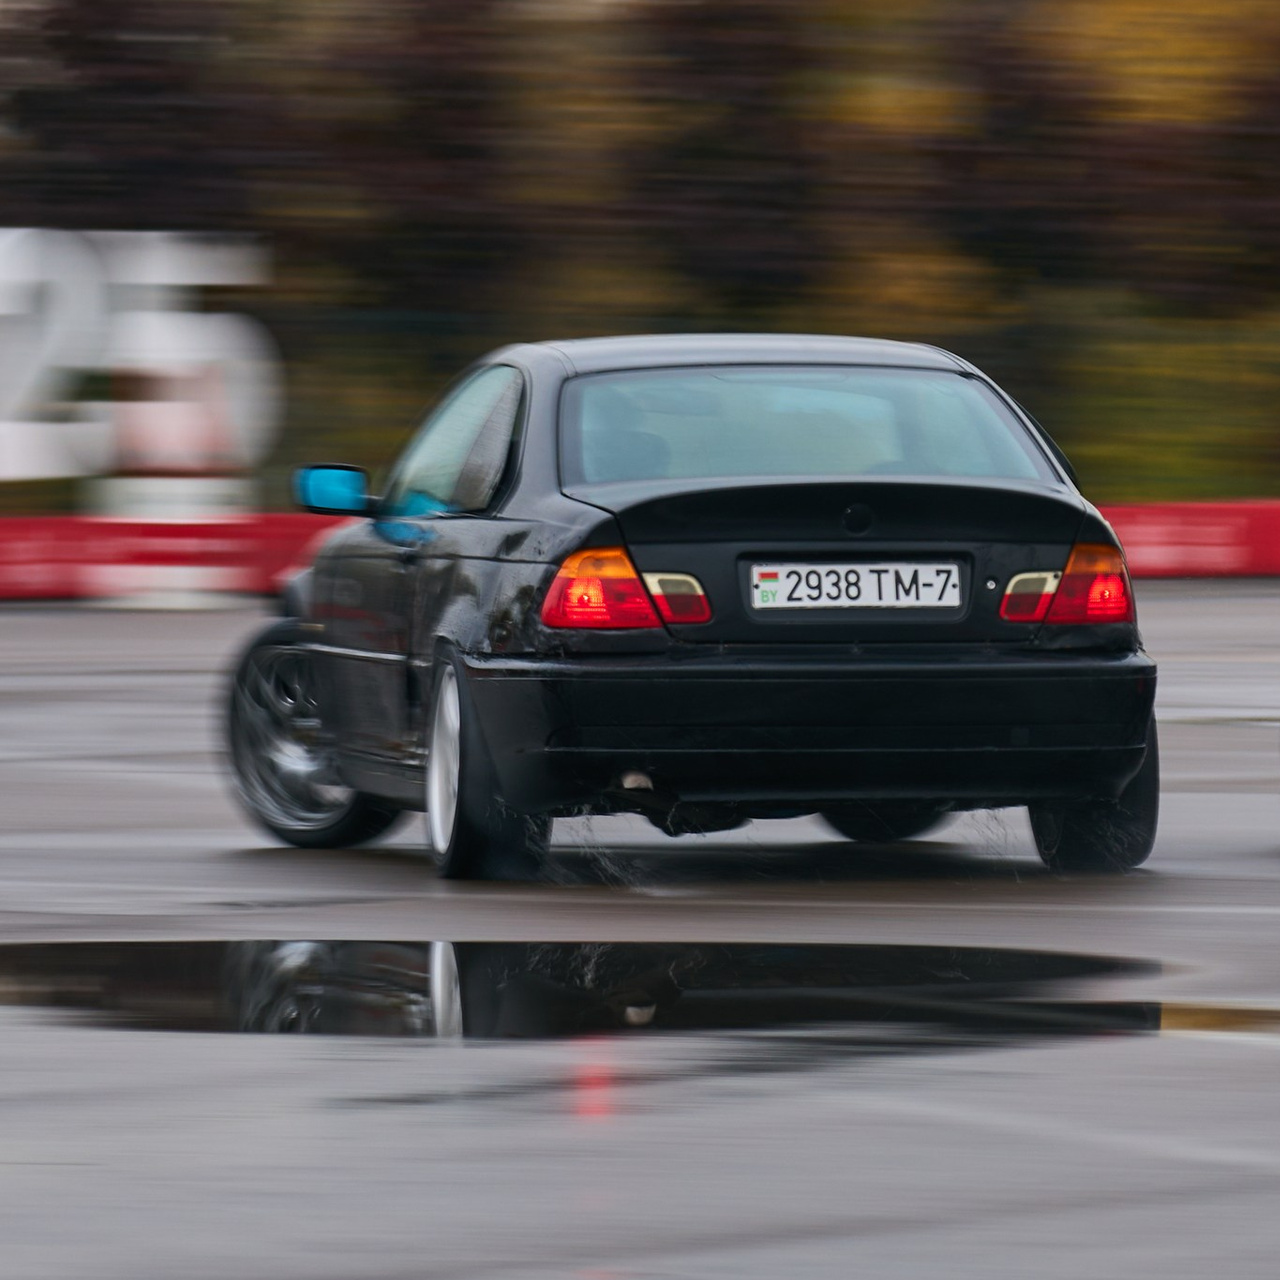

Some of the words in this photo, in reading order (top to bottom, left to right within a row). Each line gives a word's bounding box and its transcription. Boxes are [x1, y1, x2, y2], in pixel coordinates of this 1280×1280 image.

[760, 590, 778, 603] BY
[786, 570, 861, 602] 2938
[869, 569, 953, 602] TM-7
